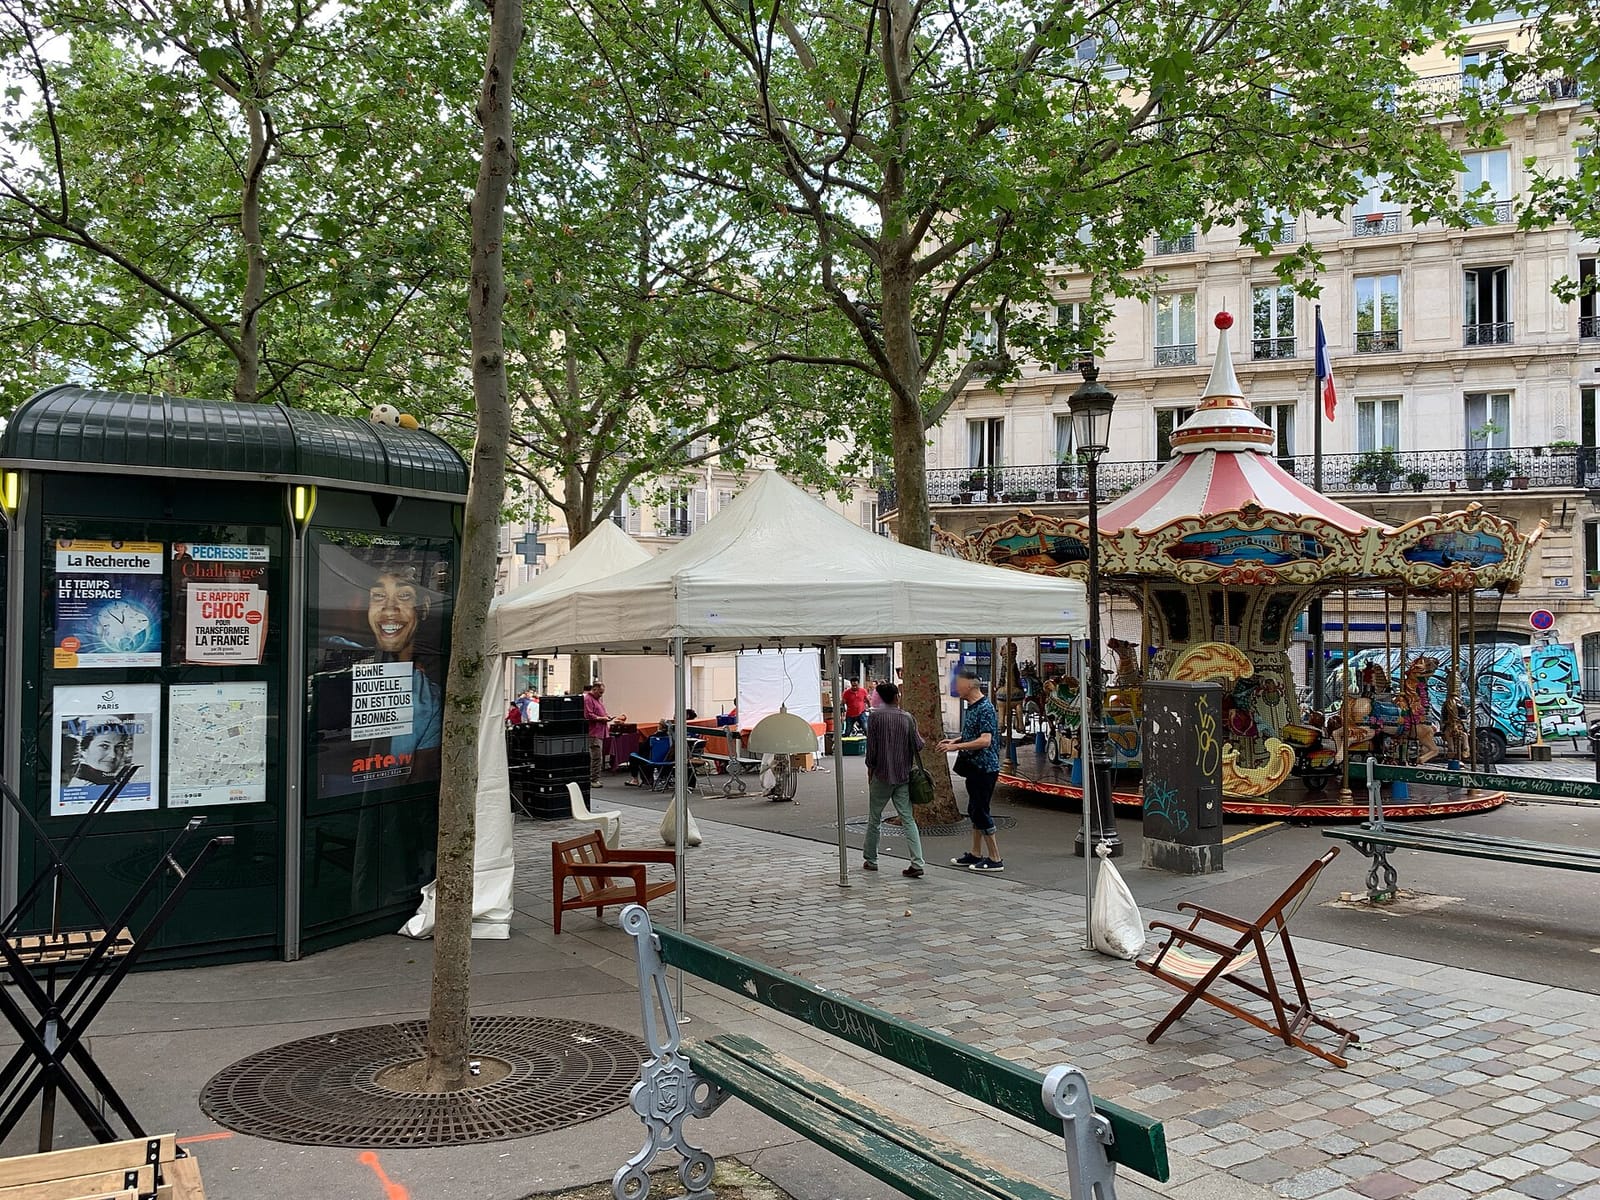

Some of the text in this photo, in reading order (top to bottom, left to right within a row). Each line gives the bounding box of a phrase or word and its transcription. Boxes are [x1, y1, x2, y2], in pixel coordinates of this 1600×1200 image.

[67, 555, 150, 568] La Recherche
[182, 562, 265, 581] Challenges
[59, 579, 110, 589] LE TEMPS
[58, 589, 122, 599] ET L'ESPACE
[196, 592, 251, 602] LE RAPPORT
[202, 602, 245, 619] CHOC
[195, 626, 250, 635] TRANSFORMER
[195, 635, 250, 646] LA FRANCE
[355, 664, 384, 677] BONNE
[355, 694, 411, 709] ON EST TOUS
